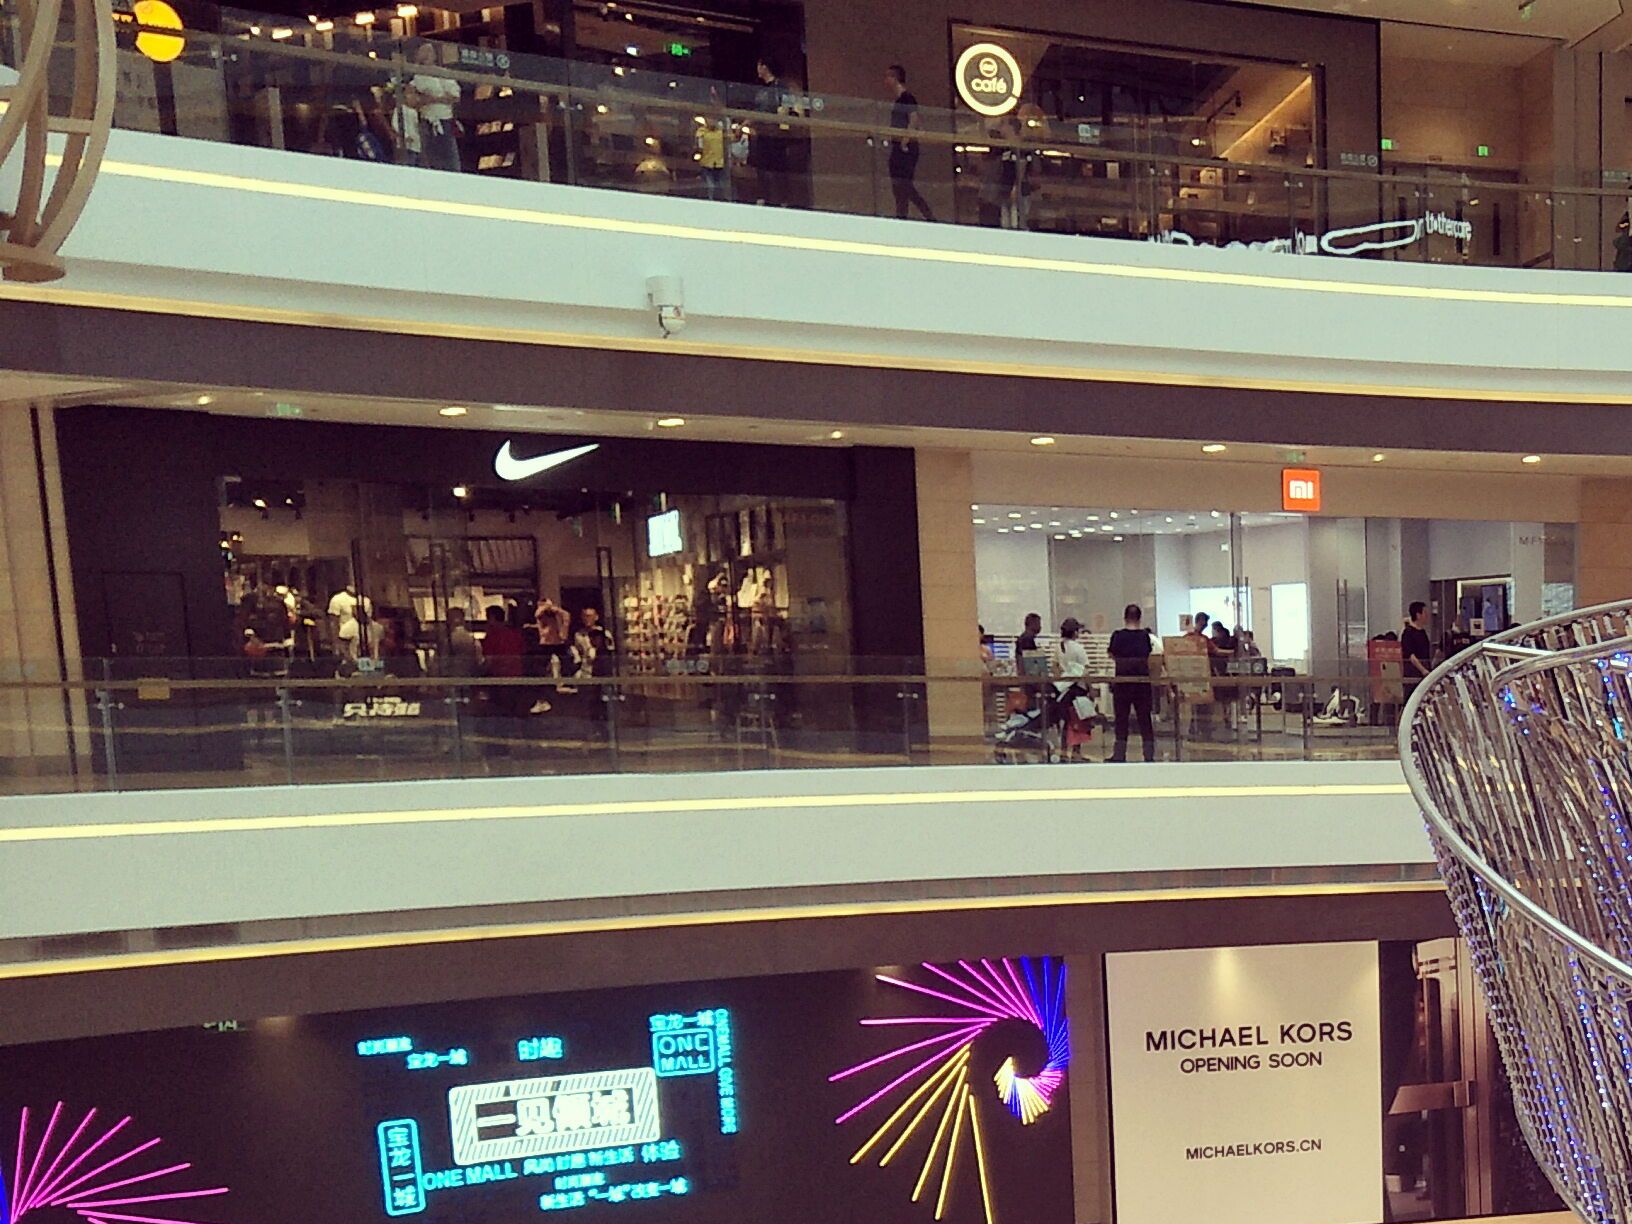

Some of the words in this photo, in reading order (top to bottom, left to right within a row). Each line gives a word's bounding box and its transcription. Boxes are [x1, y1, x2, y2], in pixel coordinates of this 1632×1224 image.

[1145, 1025, 1270, 1052] MICHAEL
[1279, 1021, 1354, 1045] KORS
[660, 1053, 710, 1072] MALL
[1180, 1054, 1261, 1074] OPENING
[1268, 1051, 1323, 1069] SOON
[1185, 1138, 1323, 1161] MICHAELKORS.CN
[422, 1168, 465, 1191] ONE
[465, 1161, 518, 1184] MALL
